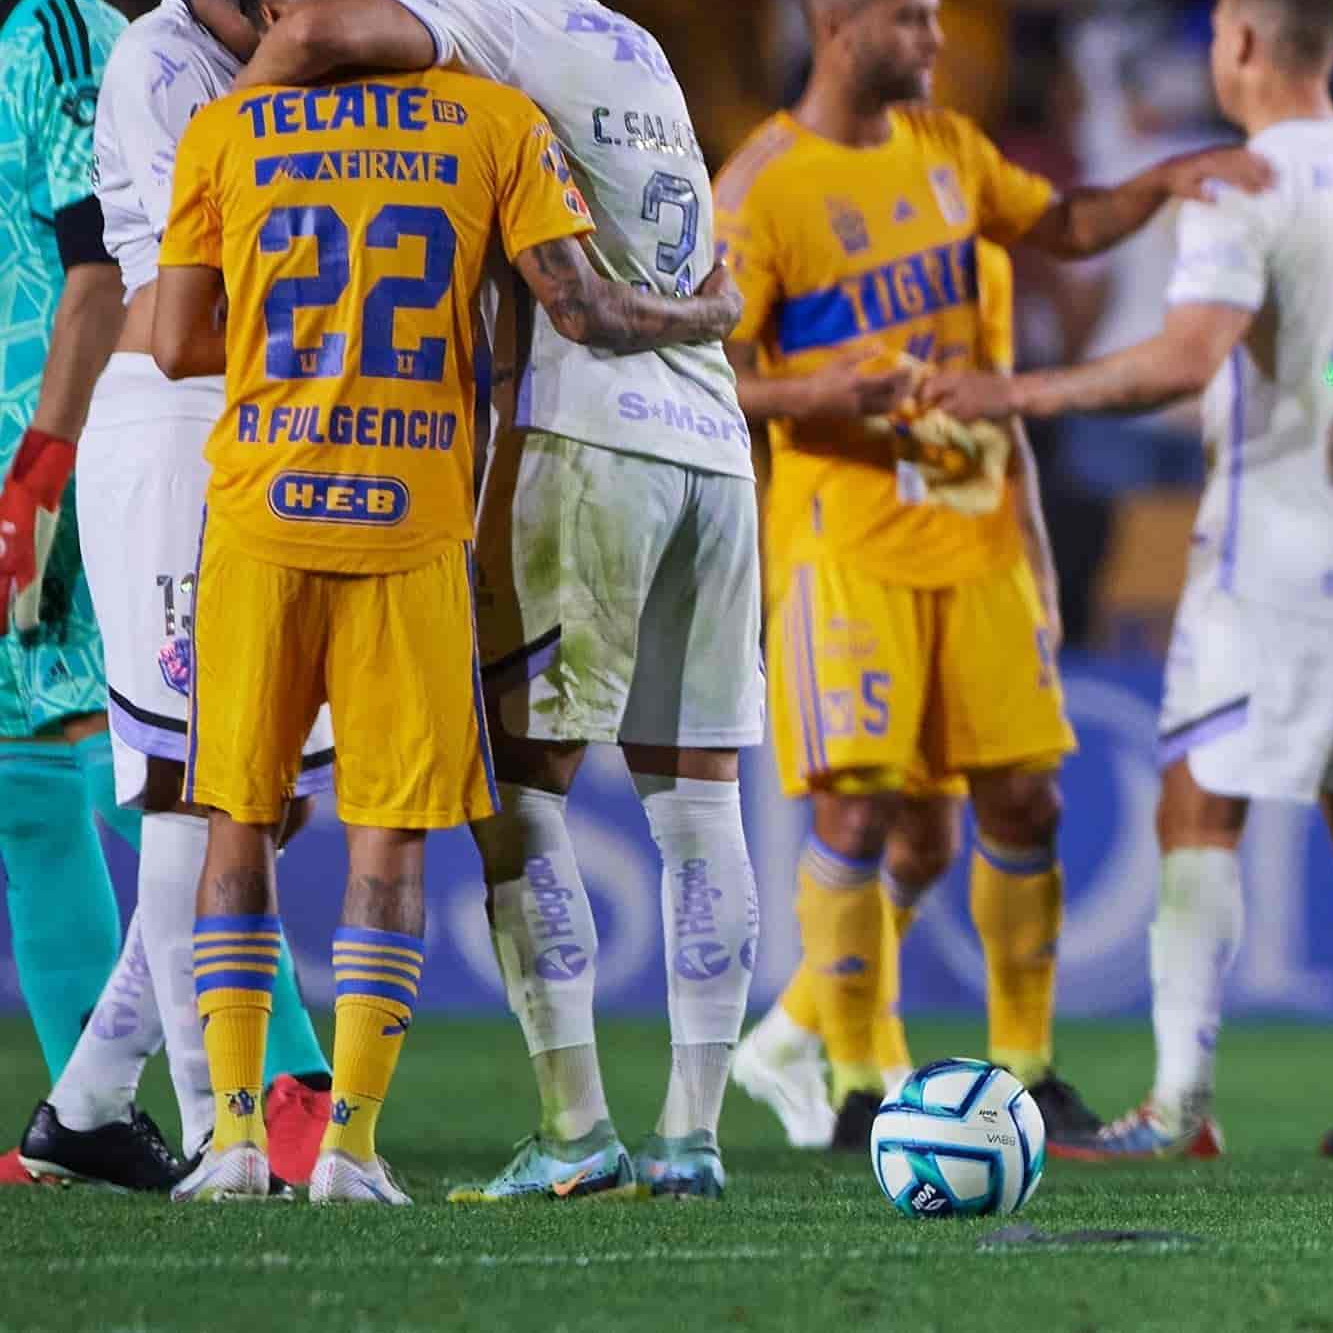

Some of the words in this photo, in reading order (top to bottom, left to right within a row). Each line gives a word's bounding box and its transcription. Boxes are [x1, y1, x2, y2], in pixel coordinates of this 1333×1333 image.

[238, 83, 429, 138] TECATE
[311, 150, 446, 182] AFIRME
[257, 204, 460, 383] 22
[861, 669, 891, 737] 5
